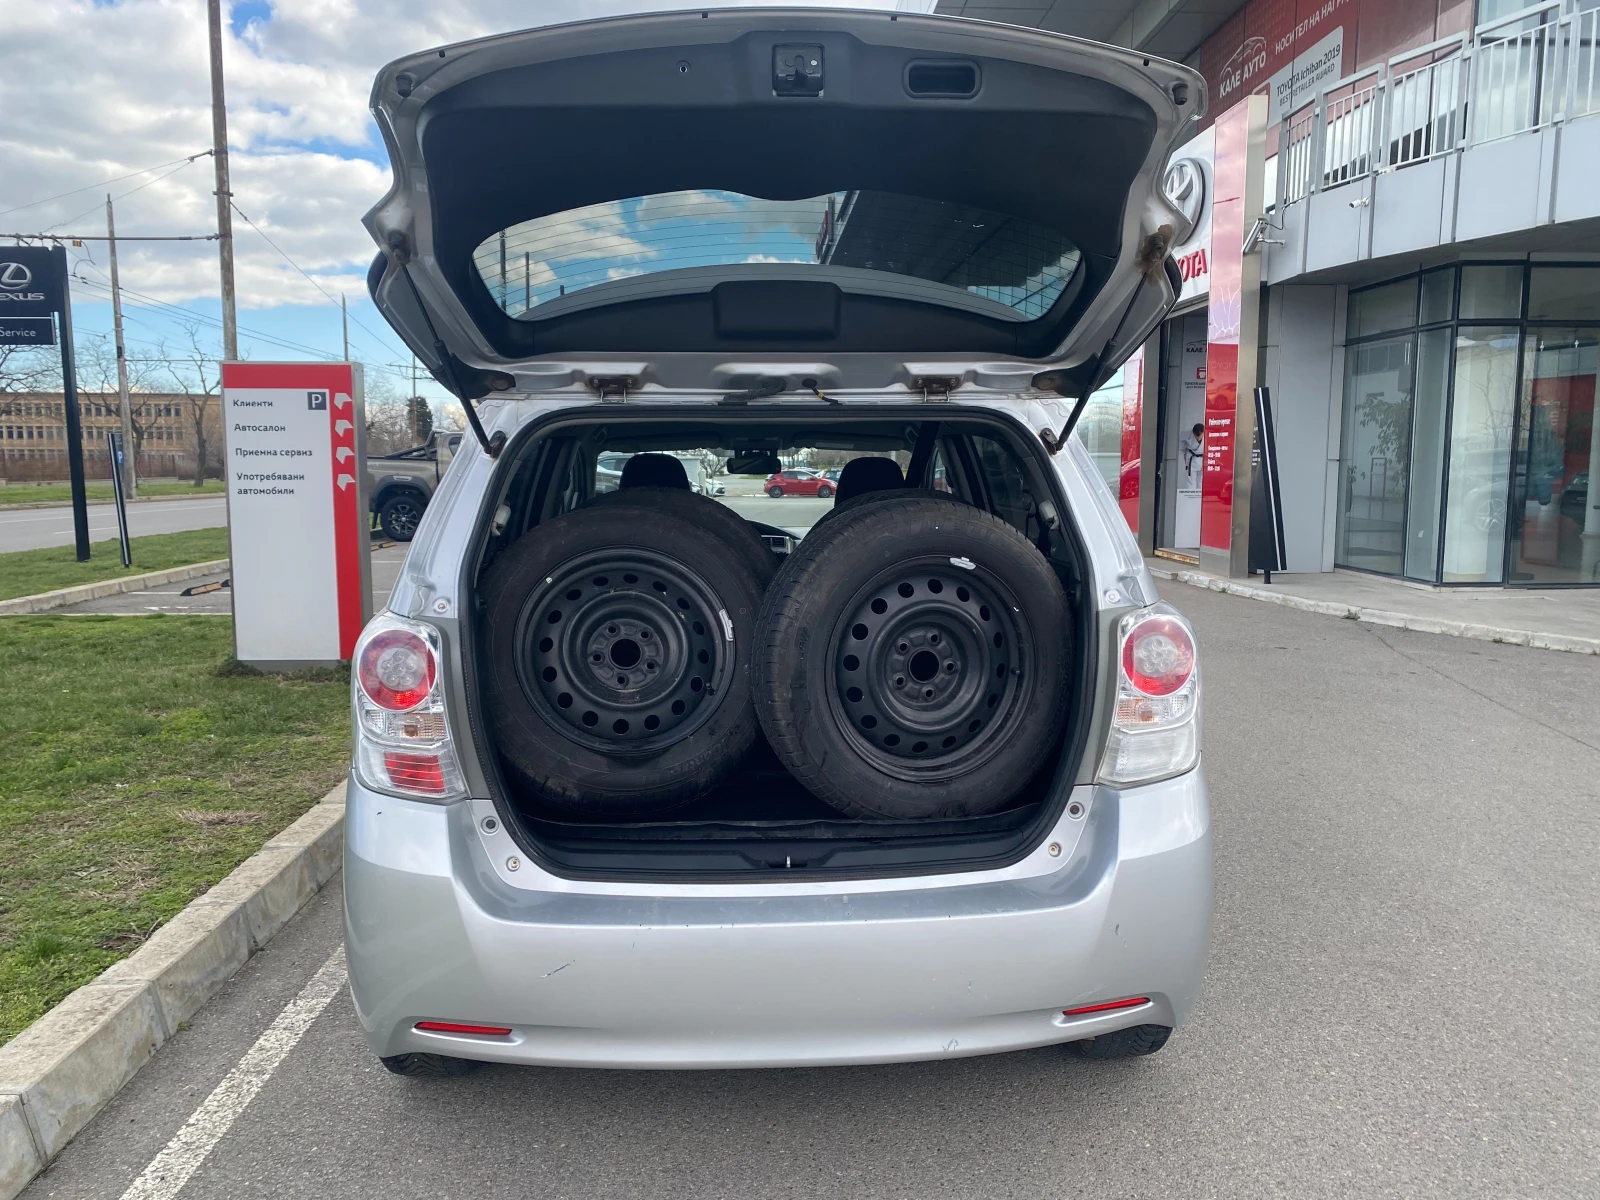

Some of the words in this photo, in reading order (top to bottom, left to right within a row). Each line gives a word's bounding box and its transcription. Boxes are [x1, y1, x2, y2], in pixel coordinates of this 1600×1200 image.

[1275, 19, 1308, 55] НОСИТЕЛ
[1309, 11, 1320, 29] НА
[1220, 70, 1241, 98] КАЛЕ
[1243, 51, 1266, 82] АУТО
[1277, 72, 1300, 97] TOYOTA
[1300, 59, 1322, 80] Ichiban
[1323, 44, 1341, 65] 2019
[1280, 92, 1291, 106] BEST
[1292, 76, 1315, 97] RETAILER
[1316, 63, 1335, 82] AWARD
[1177, 248, 1208, 283] OTA
[0, 326, 36, 337] Service
[233, 399, 273, 407] Клиенти
[311, 394, 322, 408] P
[234, 423, 286, 432] Автосалон
[235, 448, 277, 457] Приемна
[280, 449, 313, 457] сервиз
[236, 472, 305, 482] Употребявани
[237, 487, 295, 495] автомобили
